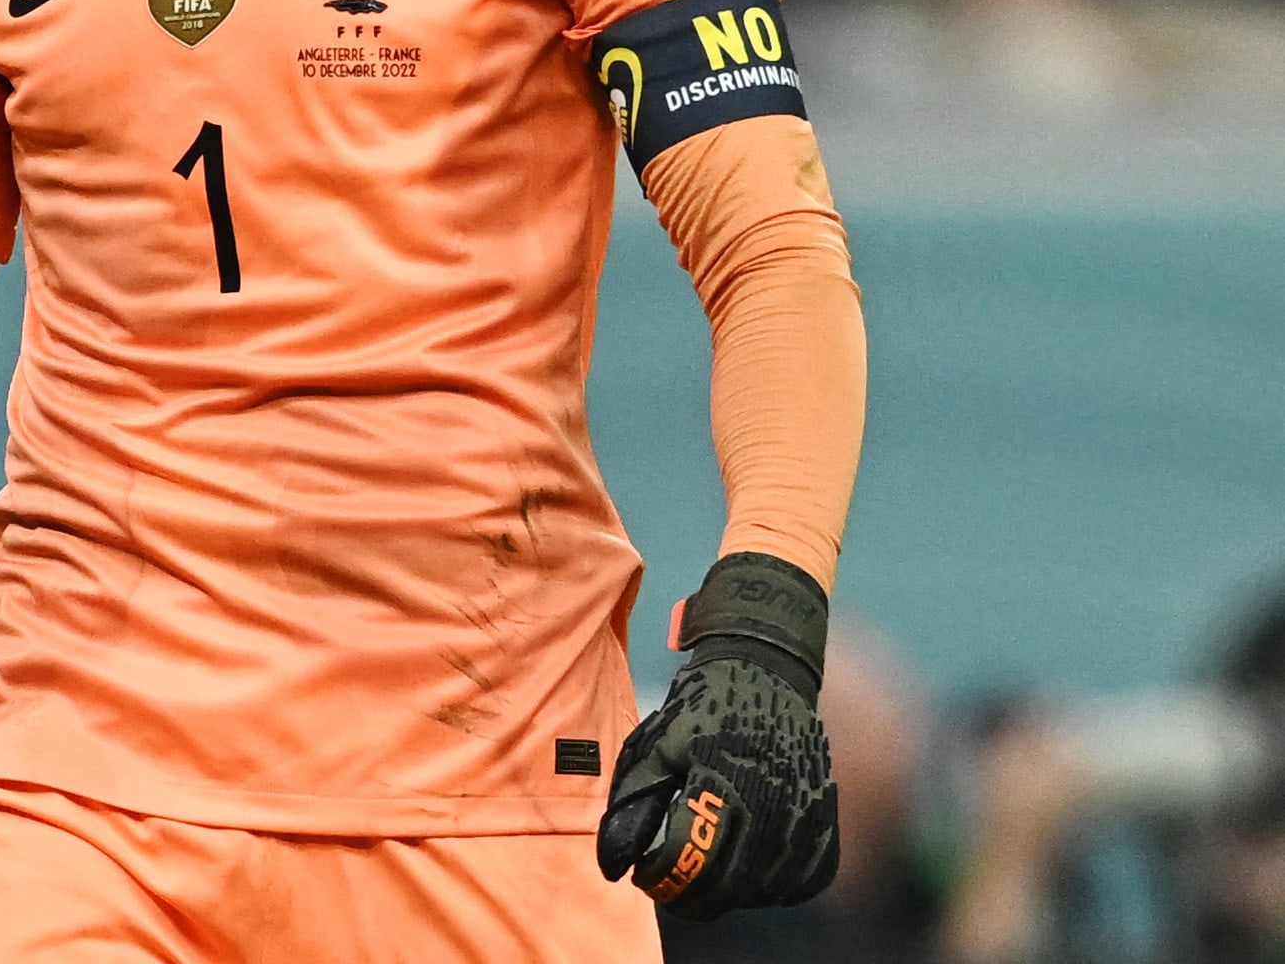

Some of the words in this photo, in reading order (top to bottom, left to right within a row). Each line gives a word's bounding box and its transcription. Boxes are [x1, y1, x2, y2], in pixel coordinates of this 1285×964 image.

[182, 20, 204, 30] 2018
[692, 6, 782, 71] NO
[298, 47, 365, 62] ANGLETERRE
[379, 47, 421, 62] FRANCE
[303, 64, 316, 78] 10
[320, 63, 377, 78] DECEMBRE
[382, 63, 417, 78] 2022
[172, 120, 242, 294] 1
